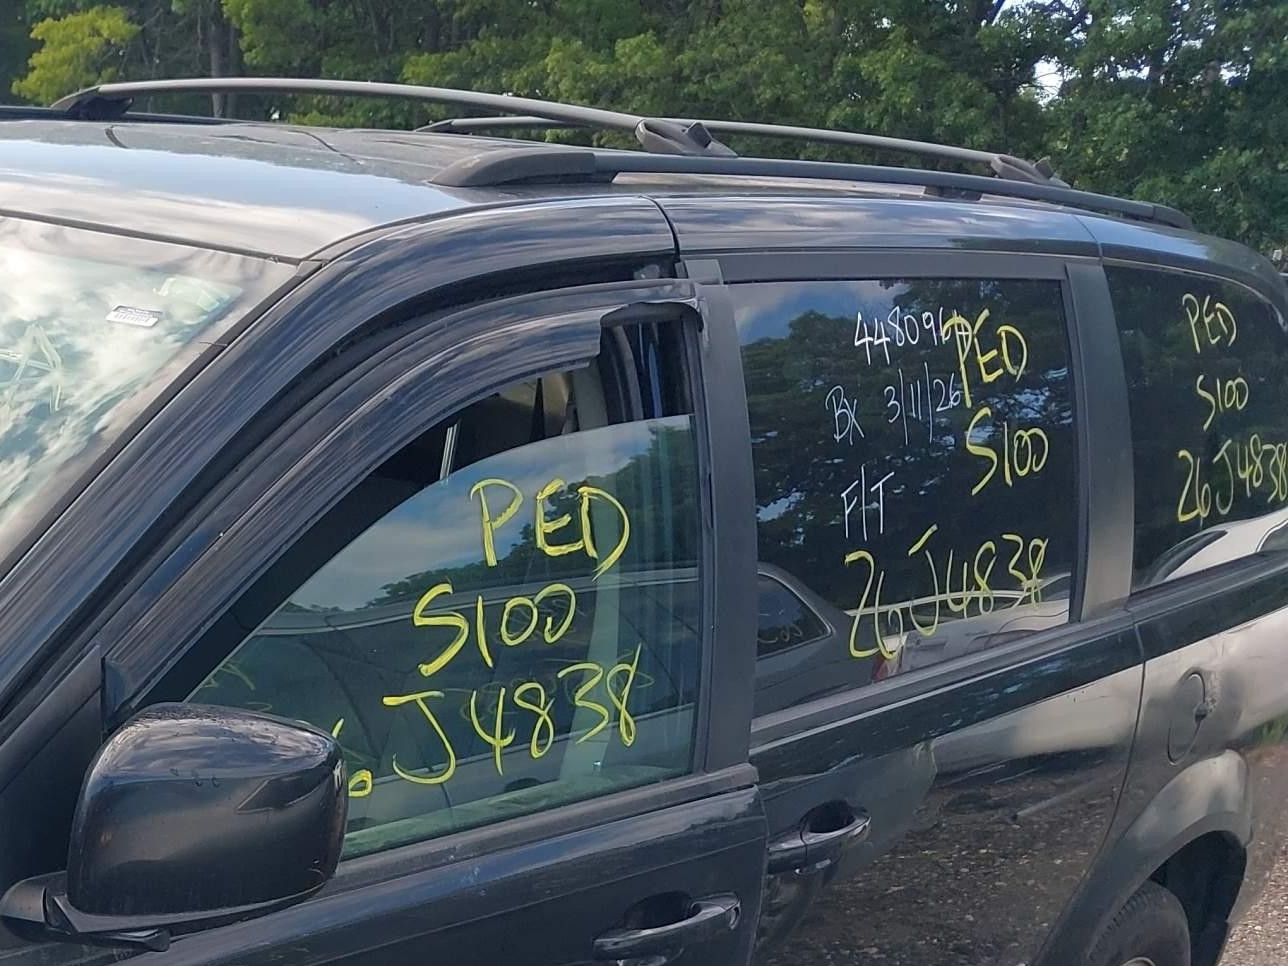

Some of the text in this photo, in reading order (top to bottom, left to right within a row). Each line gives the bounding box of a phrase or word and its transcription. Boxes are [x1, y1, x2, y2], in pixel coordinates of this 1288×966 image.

[942, 308, 1028, 408] PED
[1182, 293, 1237, 354] PED
[825, 361, 961, 446] BX 3/11/26
[1196, 374, 1249, 432] S100
[965, 406, 1049, 496] S100
[470, 479, 631, 581] PED
[412, 583, 577, 676] S100
[845, 524, 1049, 660] 26J4838
